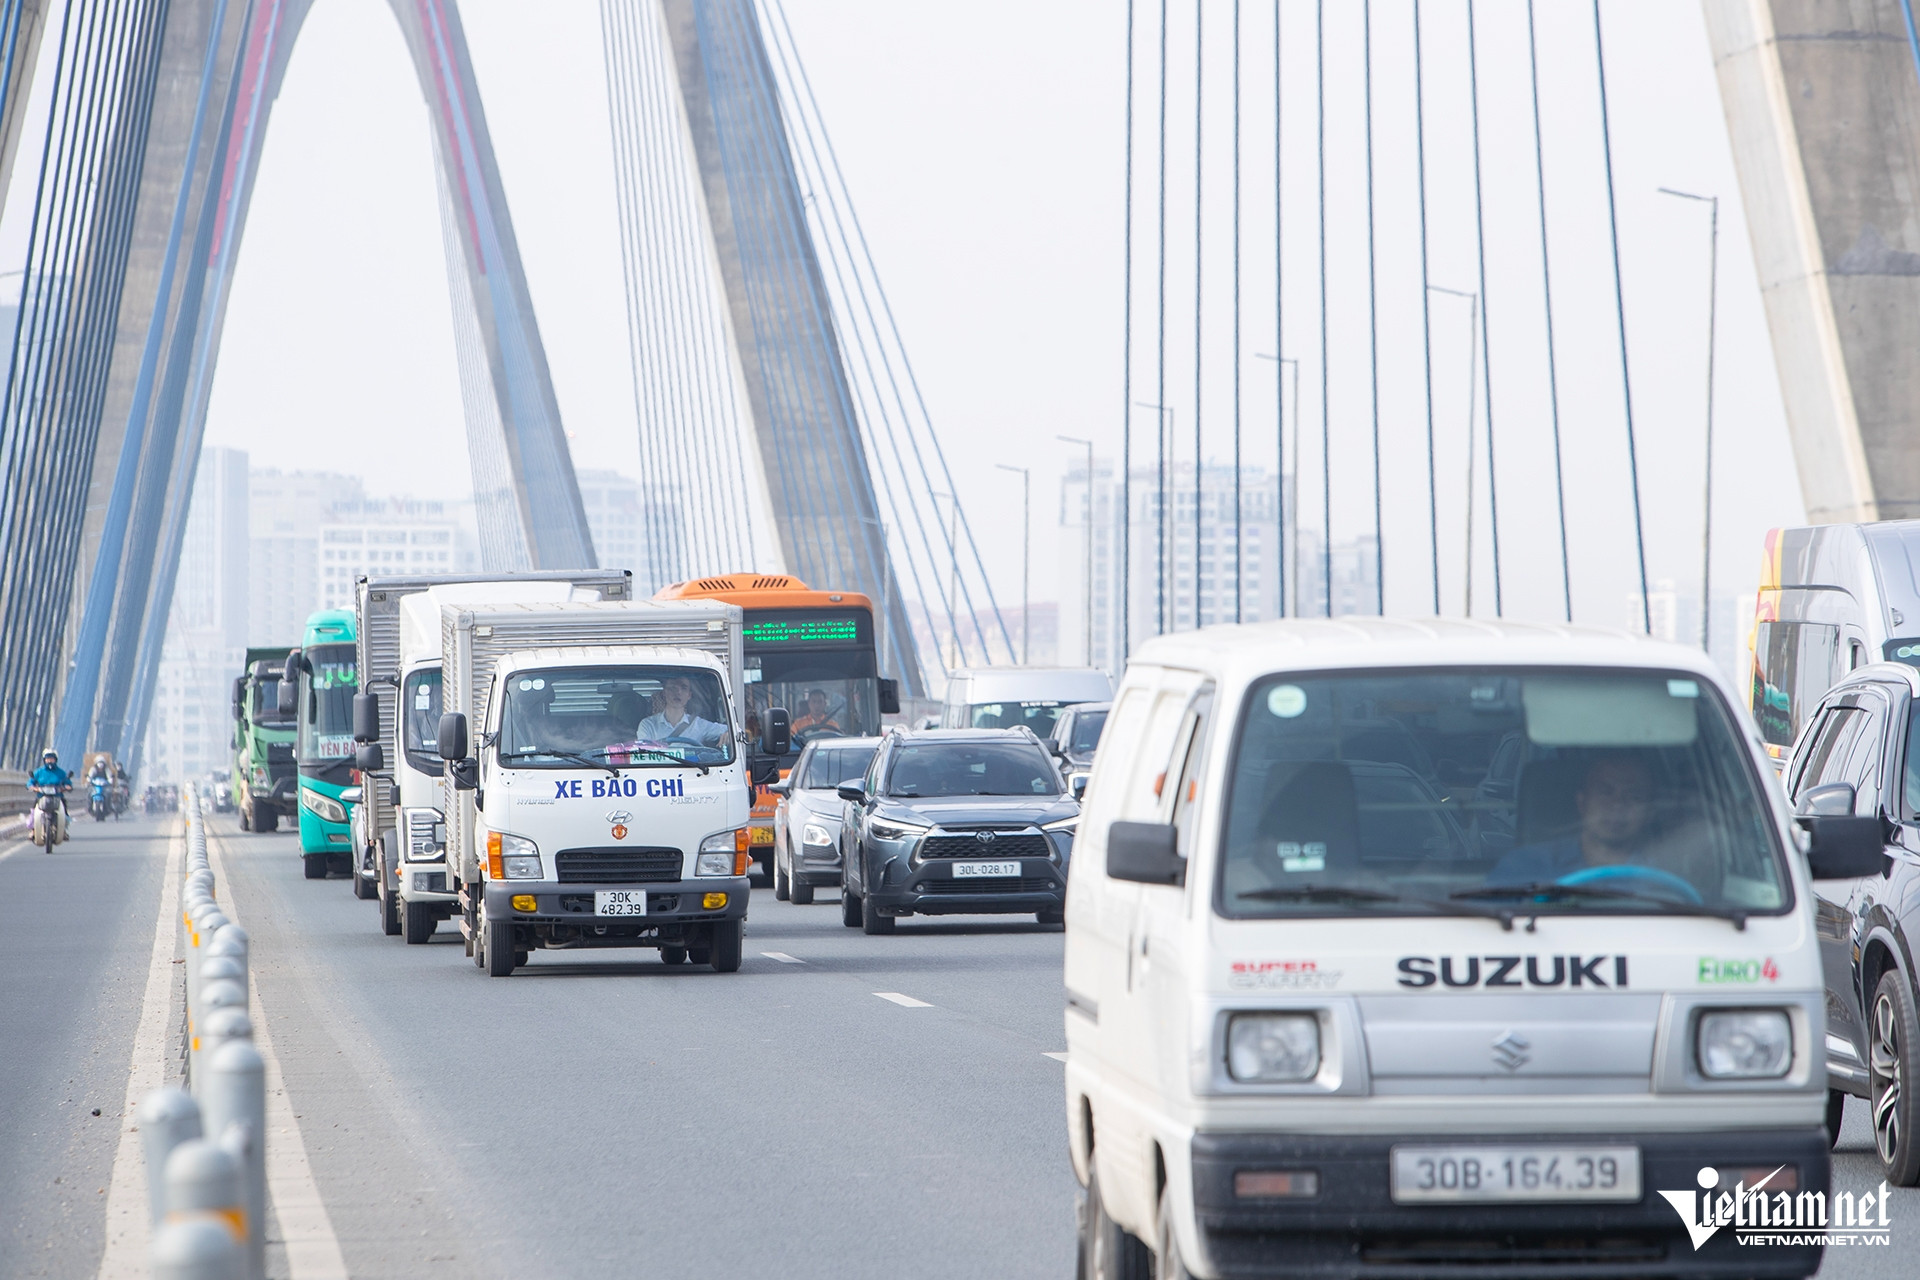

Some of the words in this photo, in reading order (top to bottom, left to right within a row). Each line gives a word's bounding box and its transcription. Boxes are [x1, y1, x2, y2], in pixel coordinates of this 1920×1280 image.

[555, 780, 582, 799] XE
[646, 774, 684, 798] CHÍ
[609, 892, 632, 903] 30K
[601, 904, 641, 915] 482.39
[1397, 956, 1628, 988] SUZUKI
